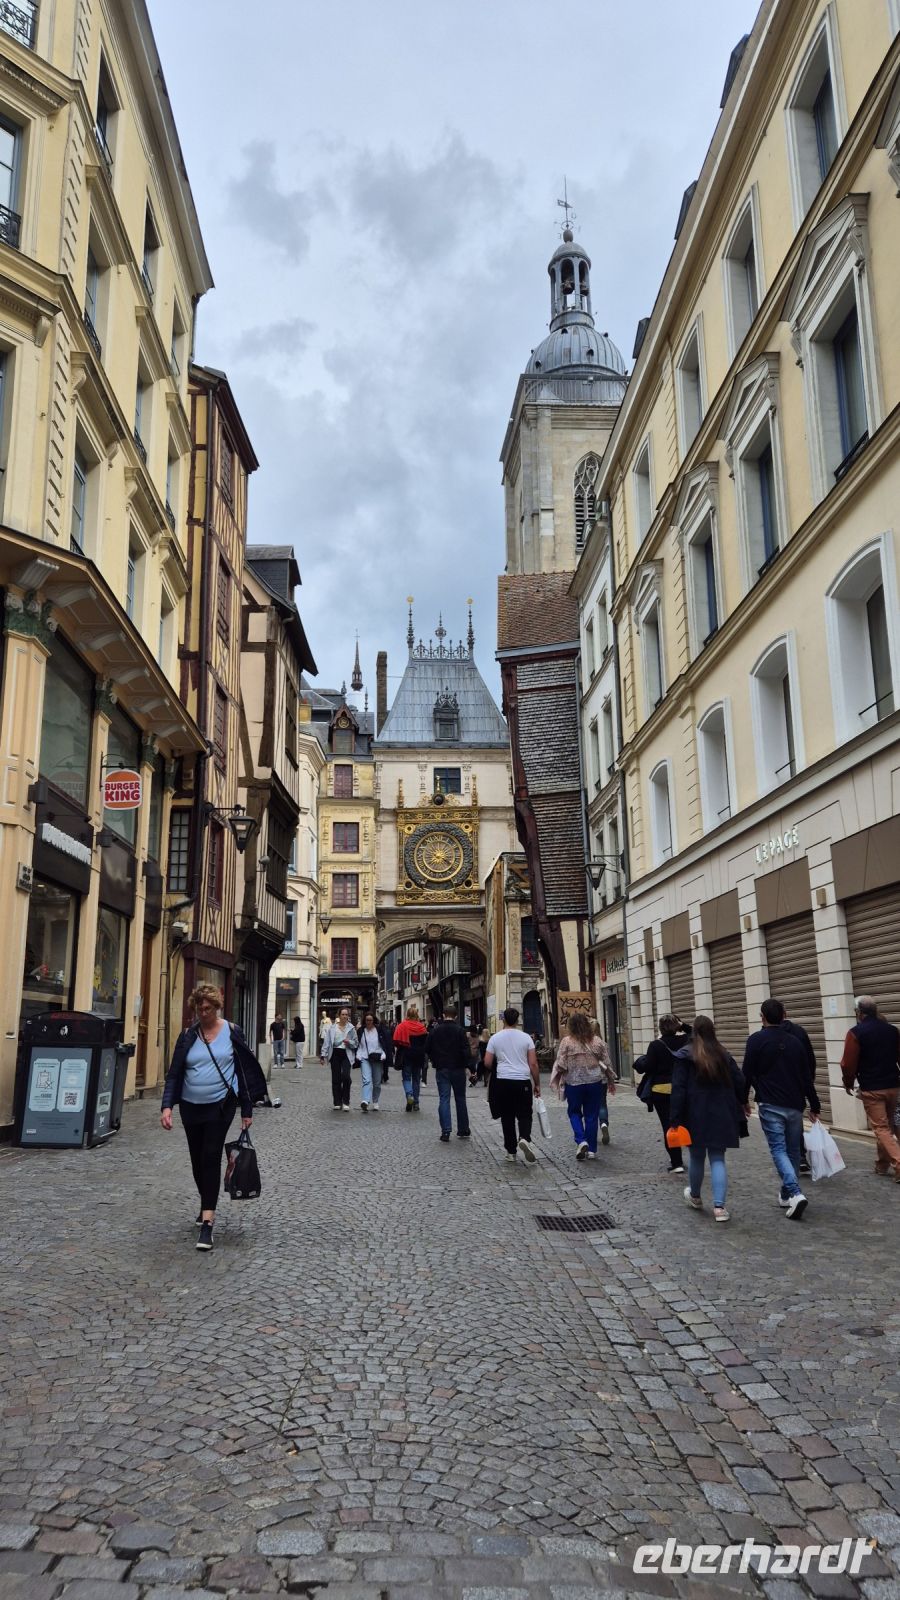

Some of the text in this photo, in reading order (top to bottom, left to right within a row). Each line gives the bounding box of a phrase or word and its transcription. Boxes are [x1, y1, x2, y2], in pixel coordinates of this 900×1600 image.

[105, 782, 140, 790] BURGER
[105, 790, 140, 801] KING
[756, 826, 799, 863] LEPAGE
